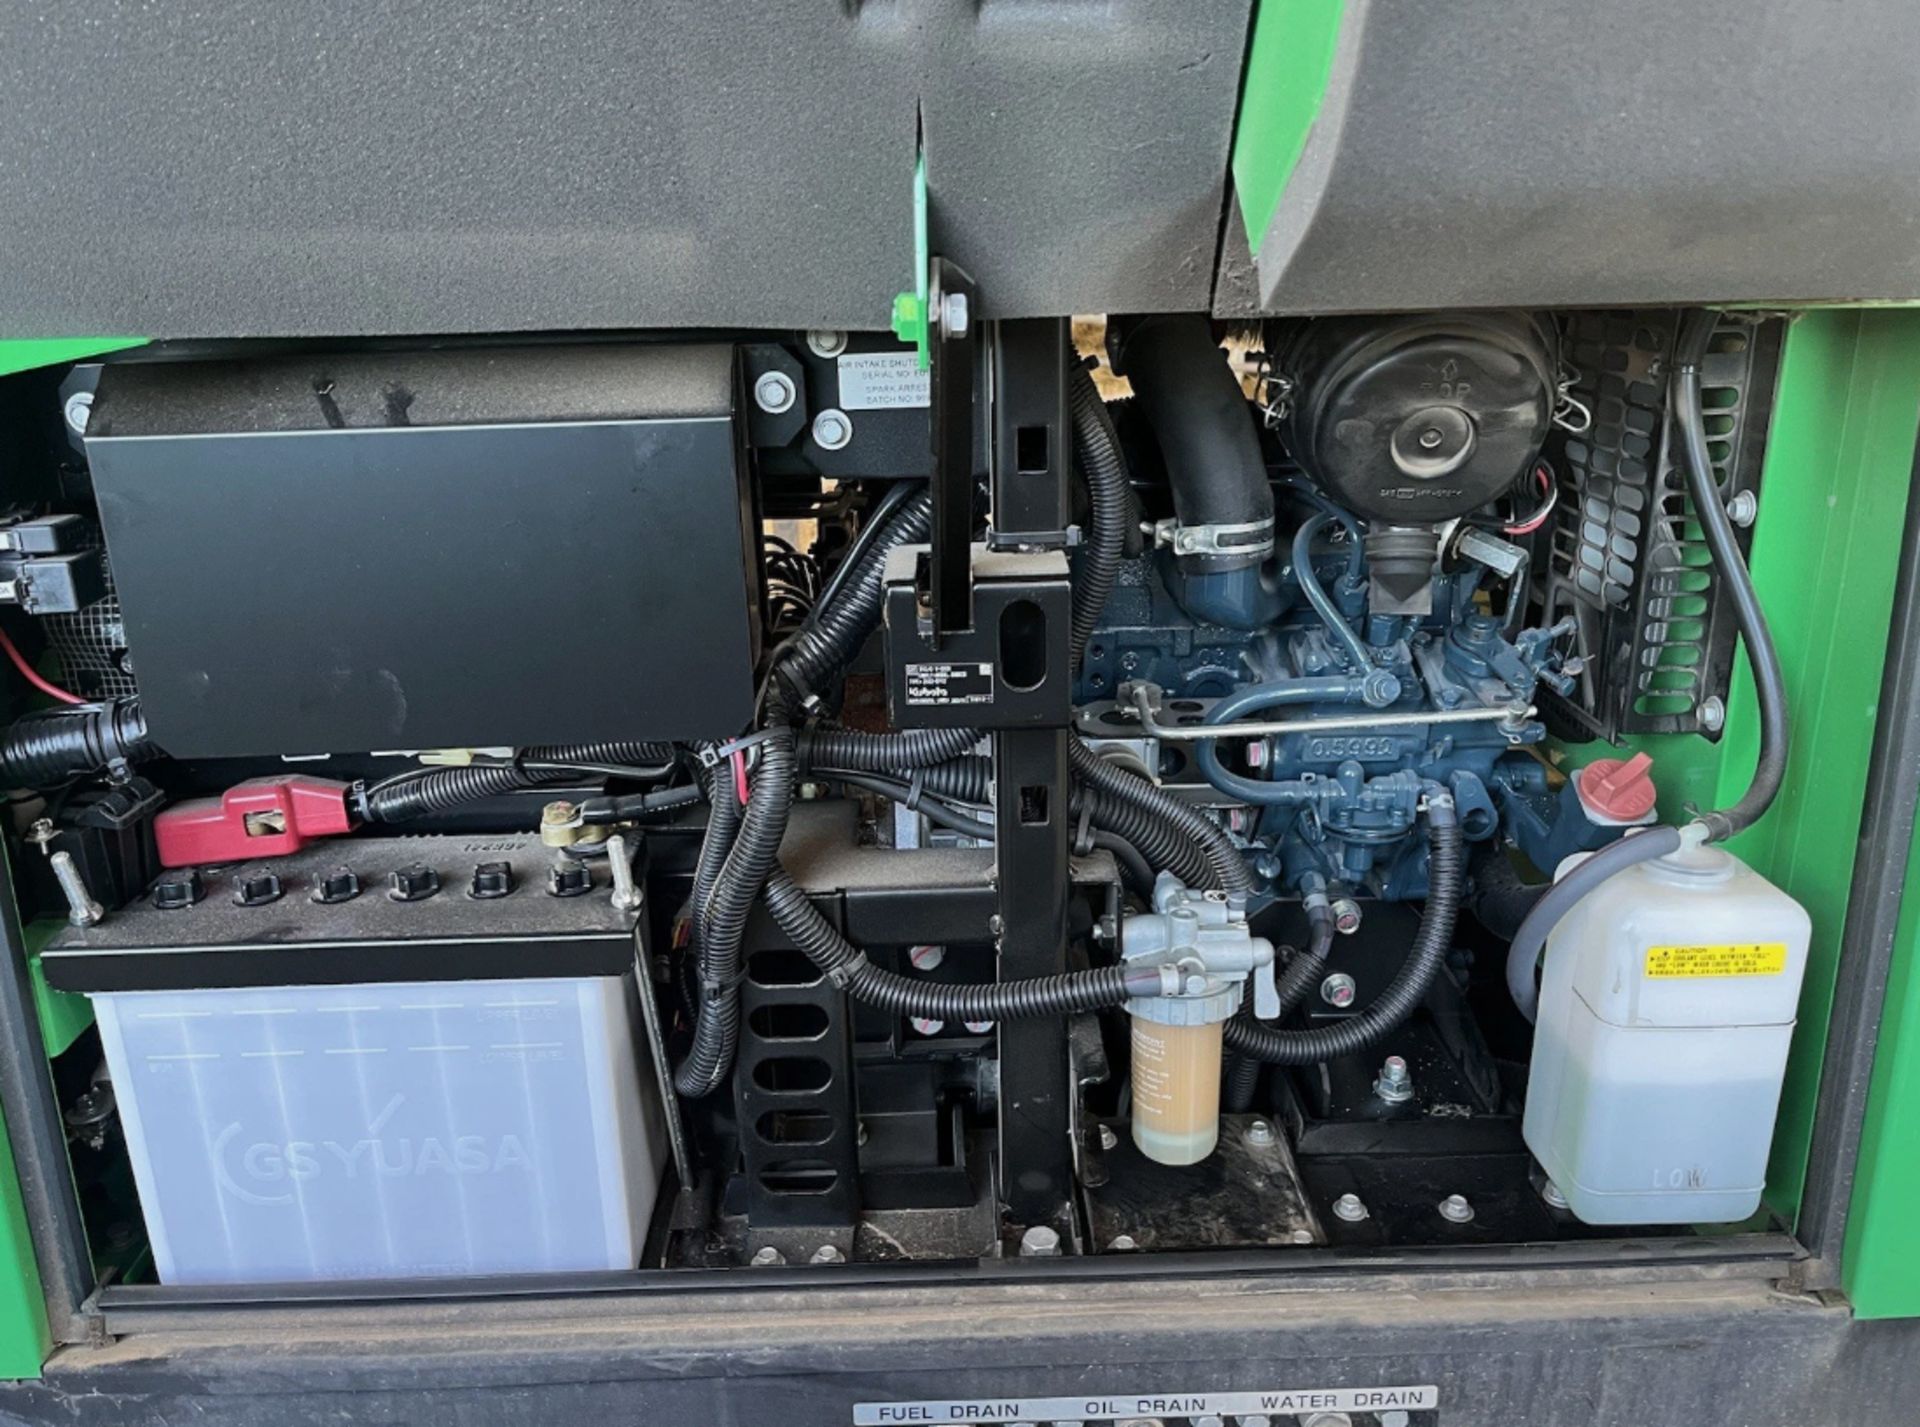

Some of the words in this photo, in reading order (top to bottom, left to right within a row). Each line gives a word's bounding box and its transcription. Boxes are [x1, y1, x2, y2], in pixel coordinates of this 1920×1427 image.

[854, 360, 887, 368] INTAKE
[908, 686, 948, 697] Kubota
[1653, 1168, 1708, 1188] LOW
[878, 1406, 934, 1421] FUEL
[949, 1404, 1020, 1419] DRAIN
[1084, 1401, 1121, 1415] OIL
[1137, 1398, 1206, 1414] DRAIN
[1260, 1394, 1338, 1410] WATER
[1353, 1391, 1424, 1406] DRAIN
